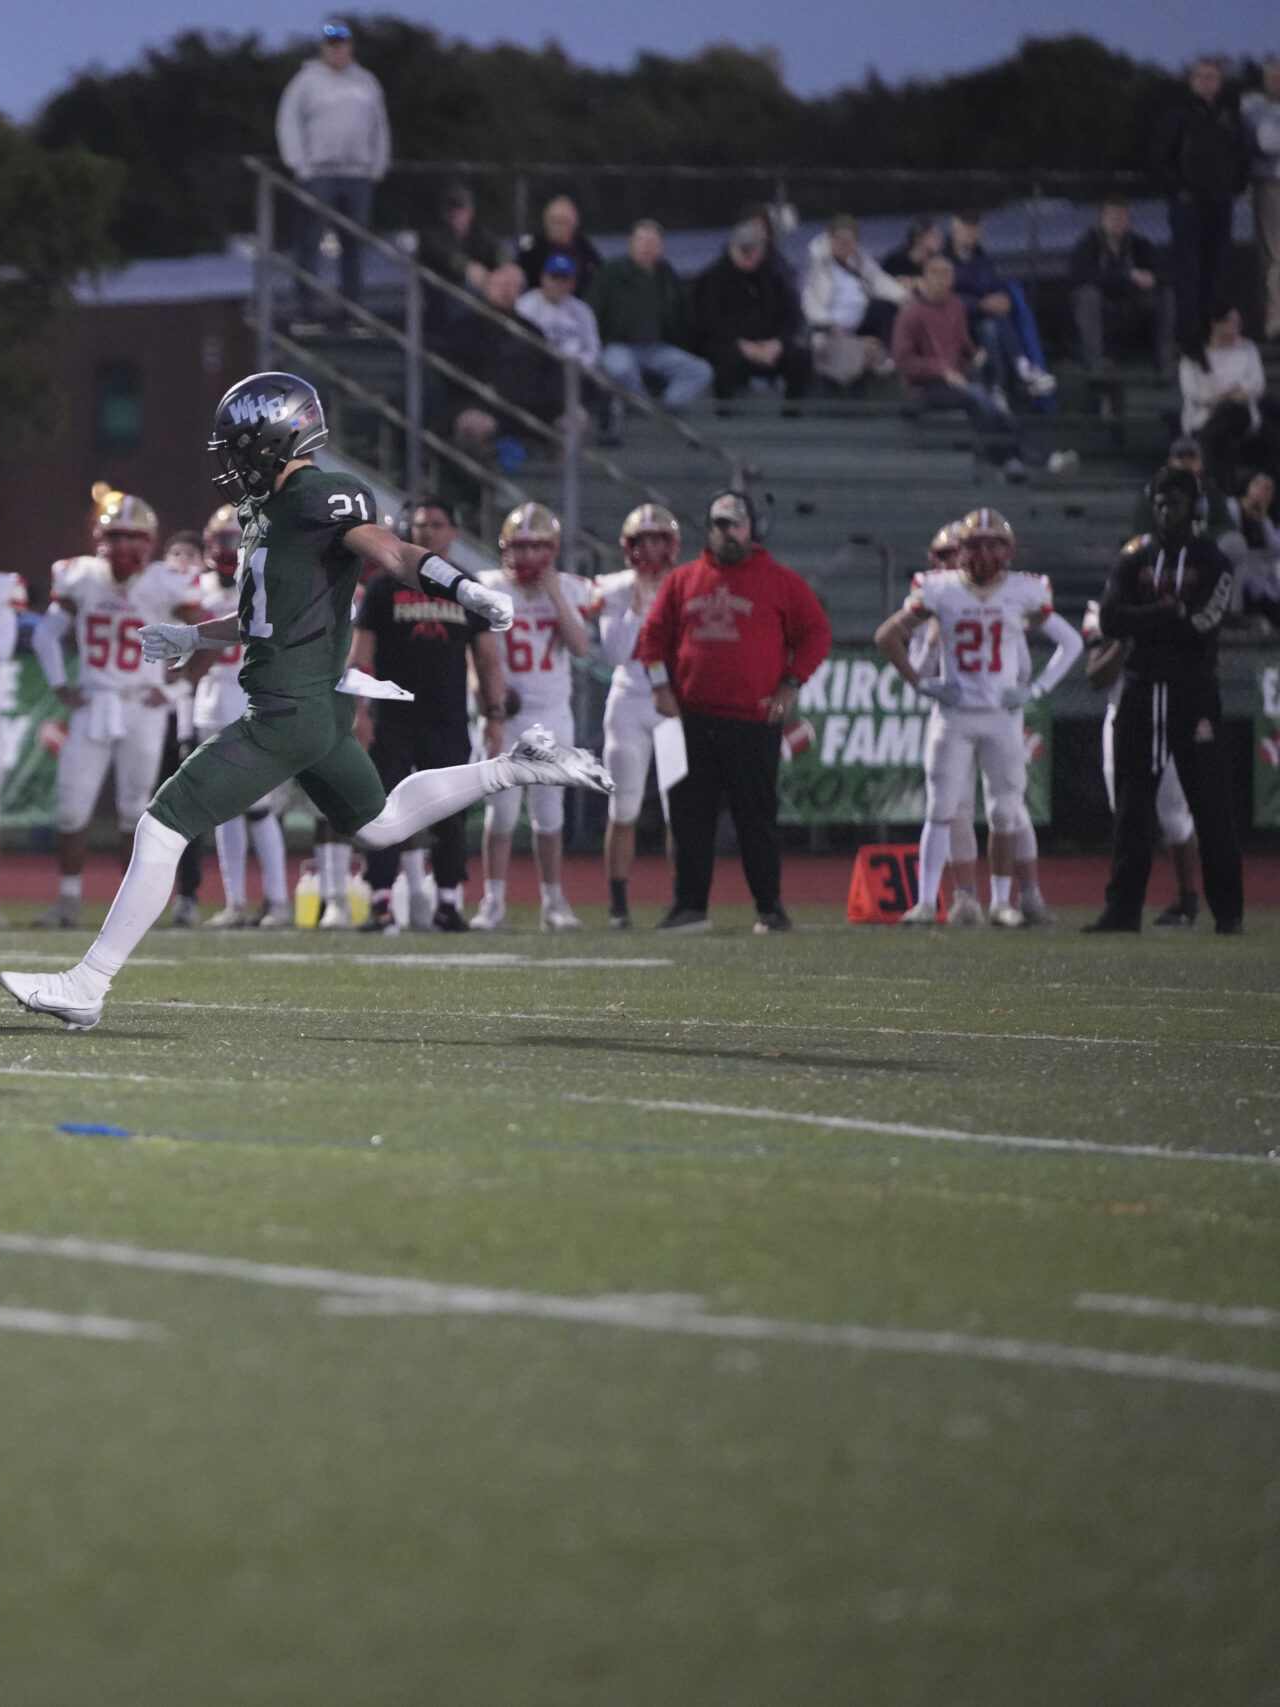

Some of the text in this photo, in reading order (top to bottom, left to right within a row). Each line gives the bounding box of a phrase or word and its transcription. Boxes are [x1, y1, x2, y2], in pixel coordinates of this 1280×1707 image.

[228, 394, 289, 426] WHB
[326, 493, 369, 522] 21
[233, 547, 273, 639] 1
[86, 615, 144, 672] 56
[505, 618, 559, 673] 67
[954, 620, 1003, 674] 21
